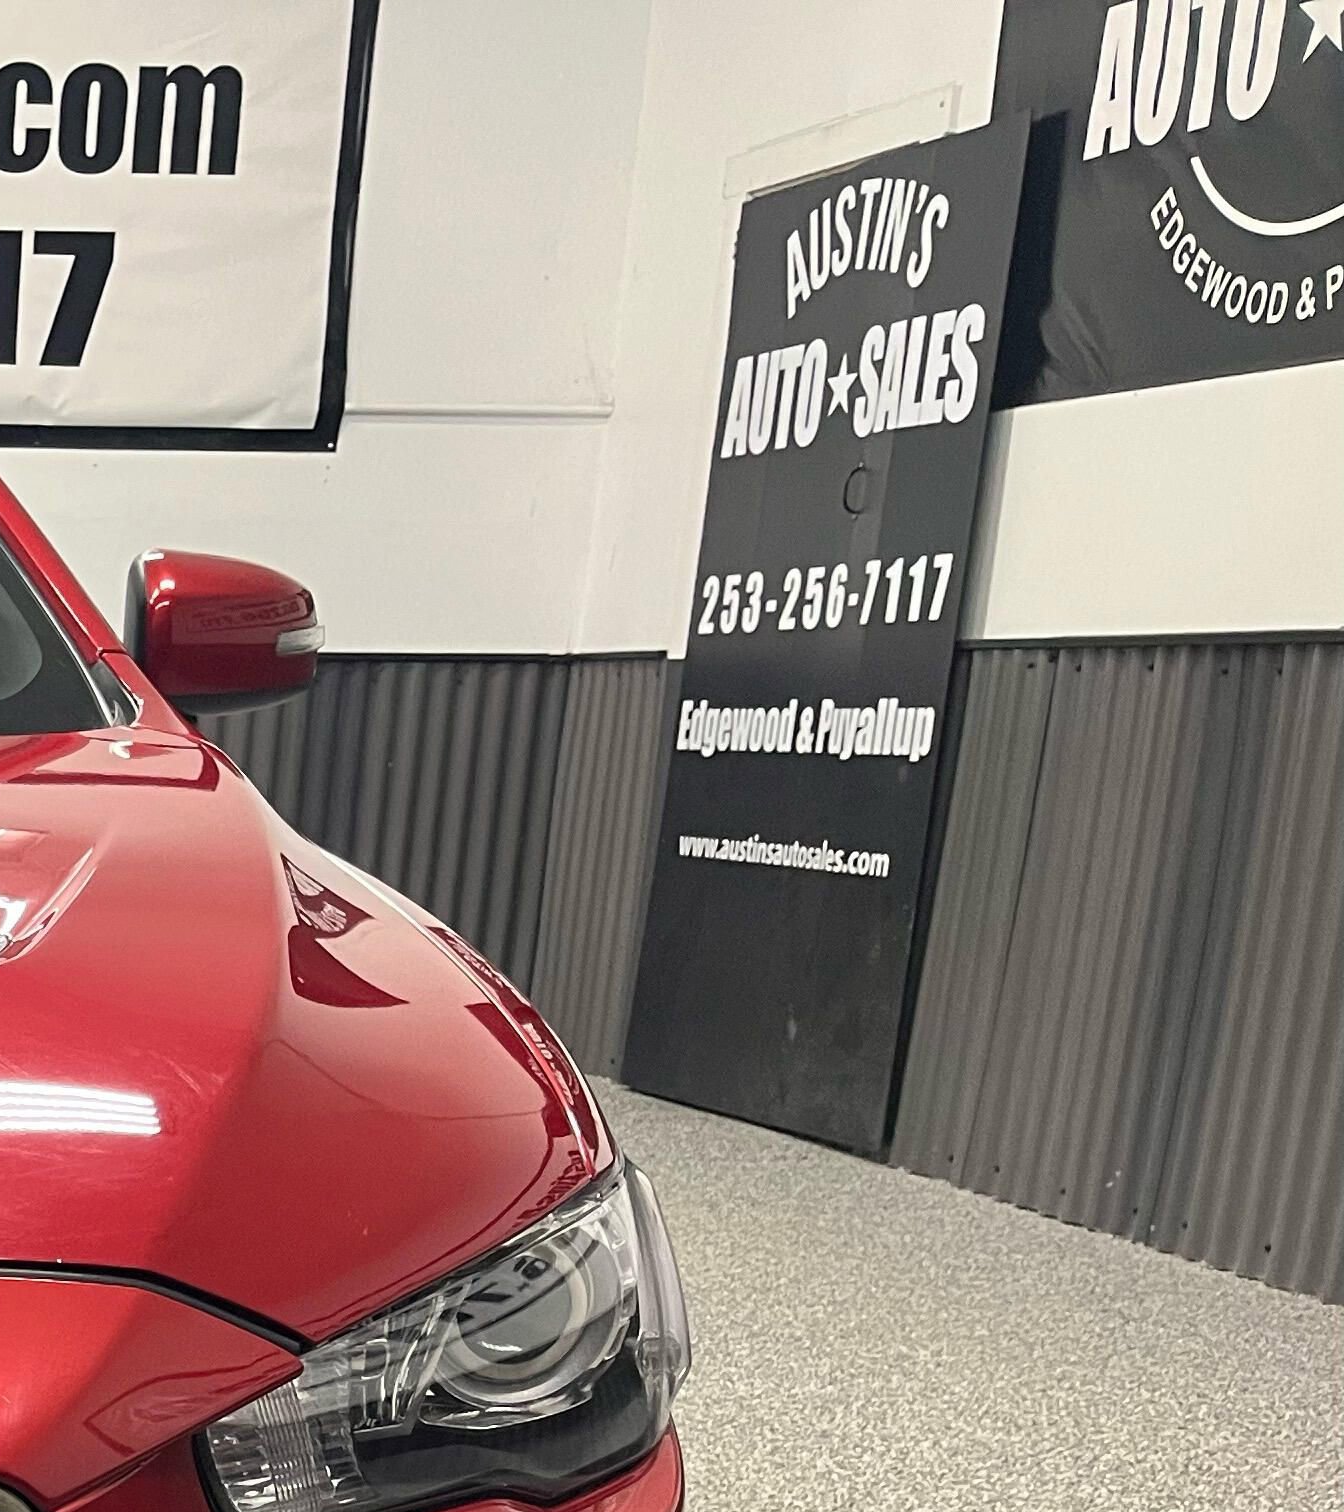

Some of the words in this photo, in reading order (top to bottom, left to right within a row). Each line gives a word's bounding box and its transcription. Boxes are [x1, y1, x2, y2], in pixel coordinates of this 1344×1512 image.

[1083, 0, 1287, 162] AUTO
[787, 177, 949, 320] AUSTIN'S
[1150, 186, 1289, 324] EDGEWOOD
[1295, 277, 1316, 321] &
[720, 338, 828, 459] AUTO
[853, 303, 985, 438] SALES
[697, 553, 954, 635] 253-256-7117
[676, 699, 798, 758] Edgewood
[795, 706, 815, 754] &
[815, 697, 935, 762] Puyallup
[678, 834, 890, 878] www.austinsautosales.com
